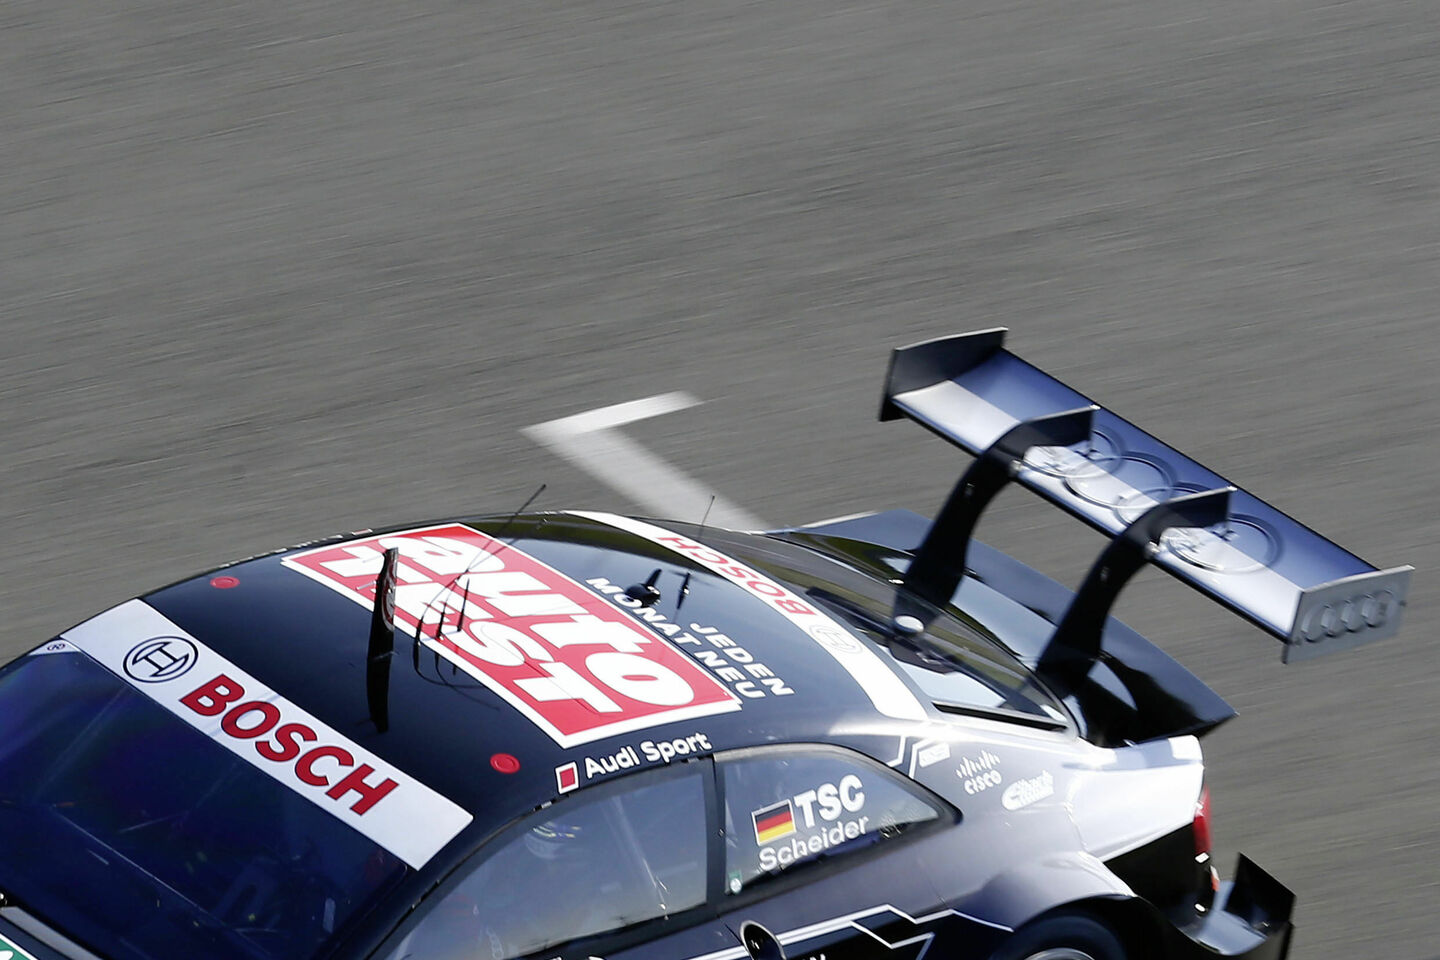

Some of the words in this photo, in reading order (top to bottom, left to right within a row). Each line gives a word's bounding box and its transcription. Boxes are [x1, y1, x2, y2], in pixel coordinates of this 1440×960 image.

[657, 537, 817, 615] BOSCH
[320, 546, 624, 713] TEST
[379, 536, 695, 706] auto
[585, 577, 702, 646] MONAT
[694, 649, 766, 698] NEU
[689, 622, 795, 696] JEDEN
[180, 674, 399, 817] BOSCH
[584, 745, 641, 780] Audi
[640, 732, 712, 764] Sport
[794, 774, 866, 827] TSC
[759, 815, 869, 872] Scheider
